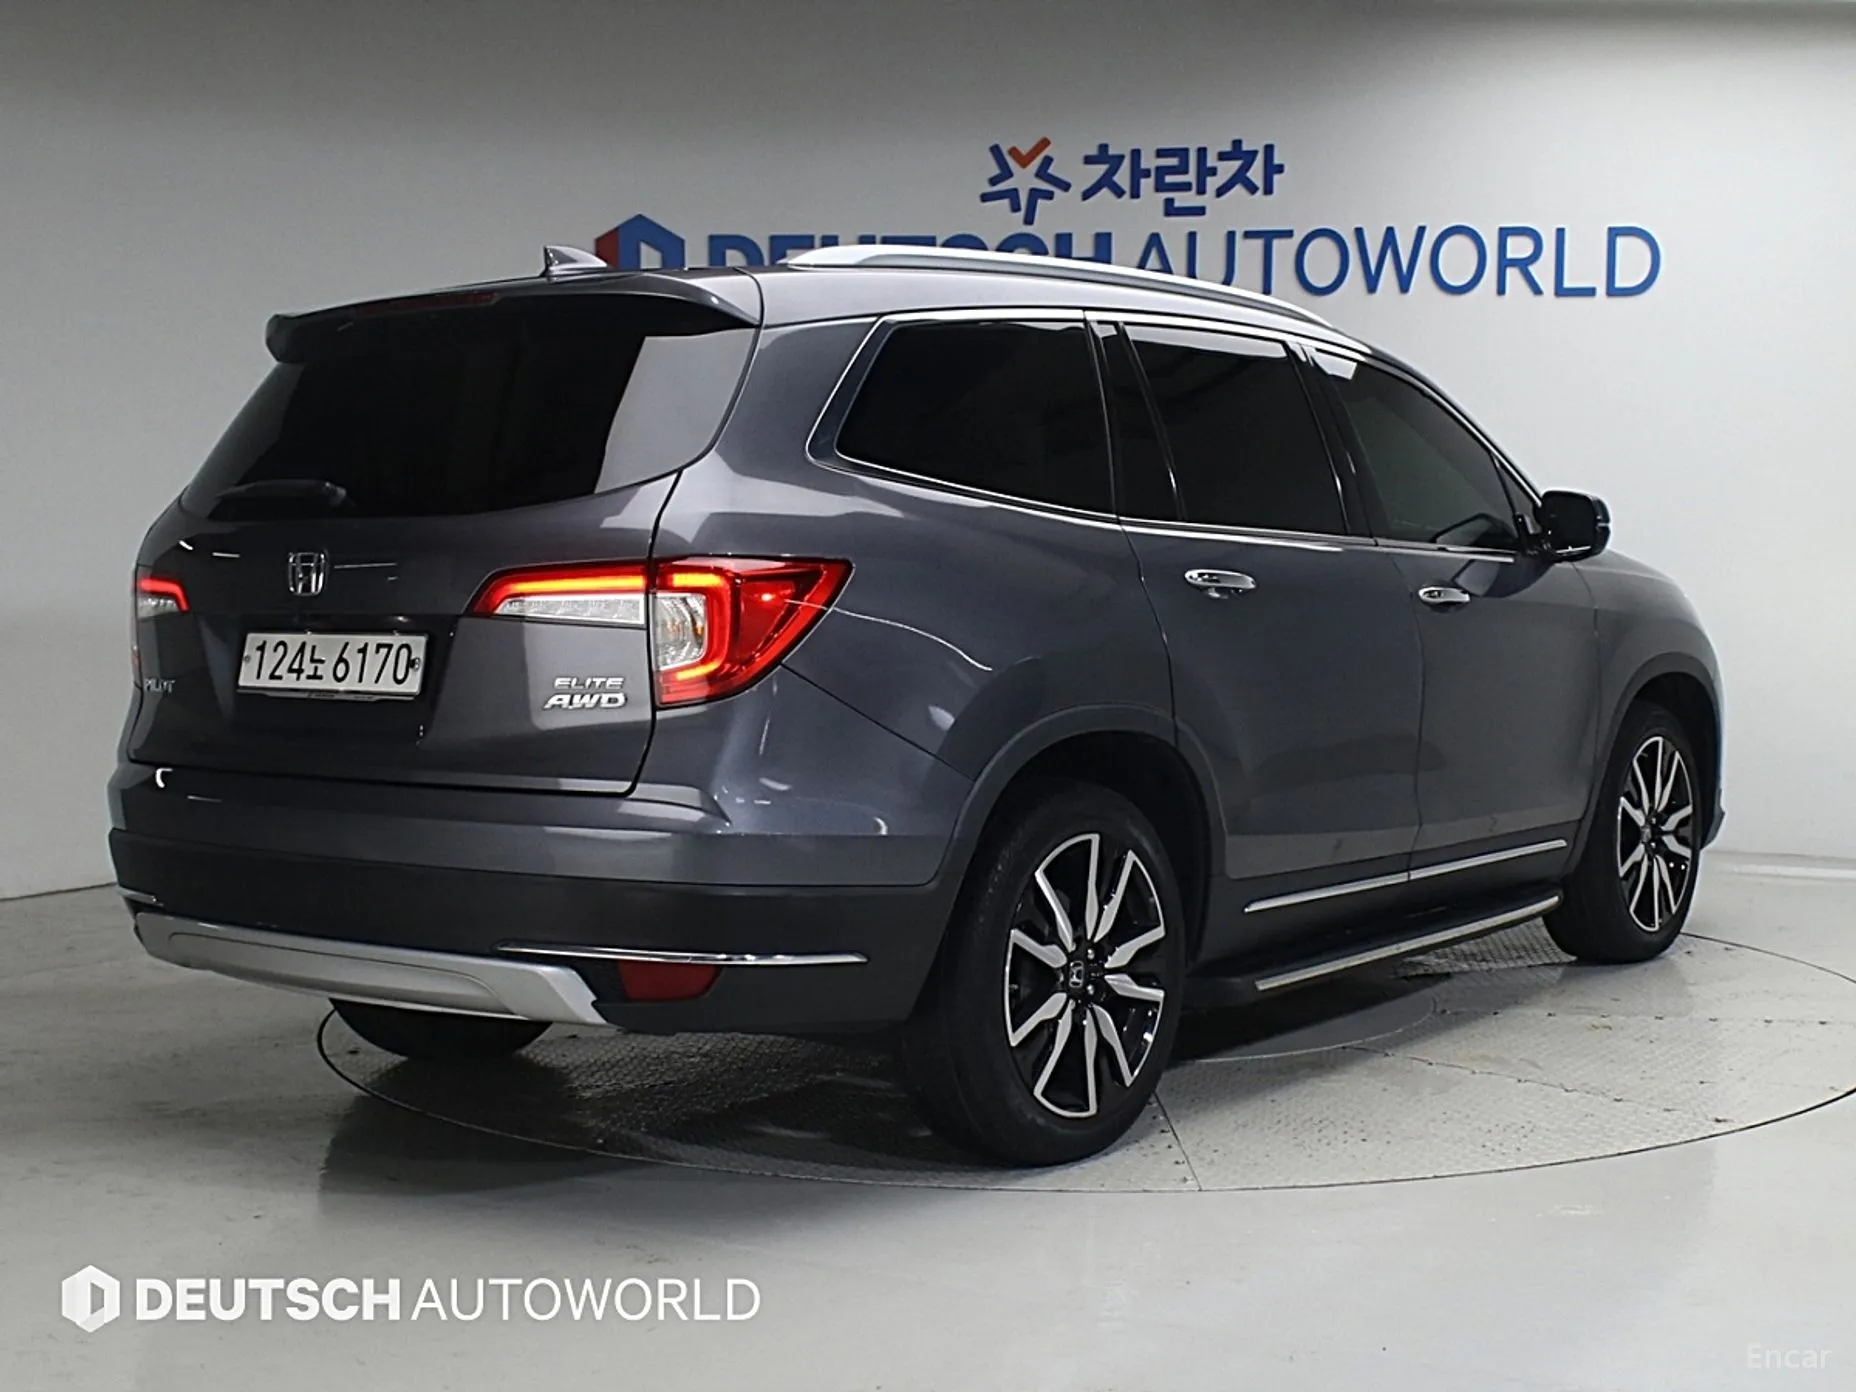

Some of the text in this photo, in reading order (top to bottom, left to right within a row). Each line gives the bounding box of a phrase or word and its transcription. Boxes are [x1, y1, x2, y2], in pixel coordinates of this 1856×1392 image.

[1081, 138, 1286, 218] 차란차
[1135, 224, 1662, 298] AUTOWORLD
[254, 639, 413, 685] 124노 6170
[553, 676, 625, 690] ELITE
[543, 692, 627, 710] AWD
